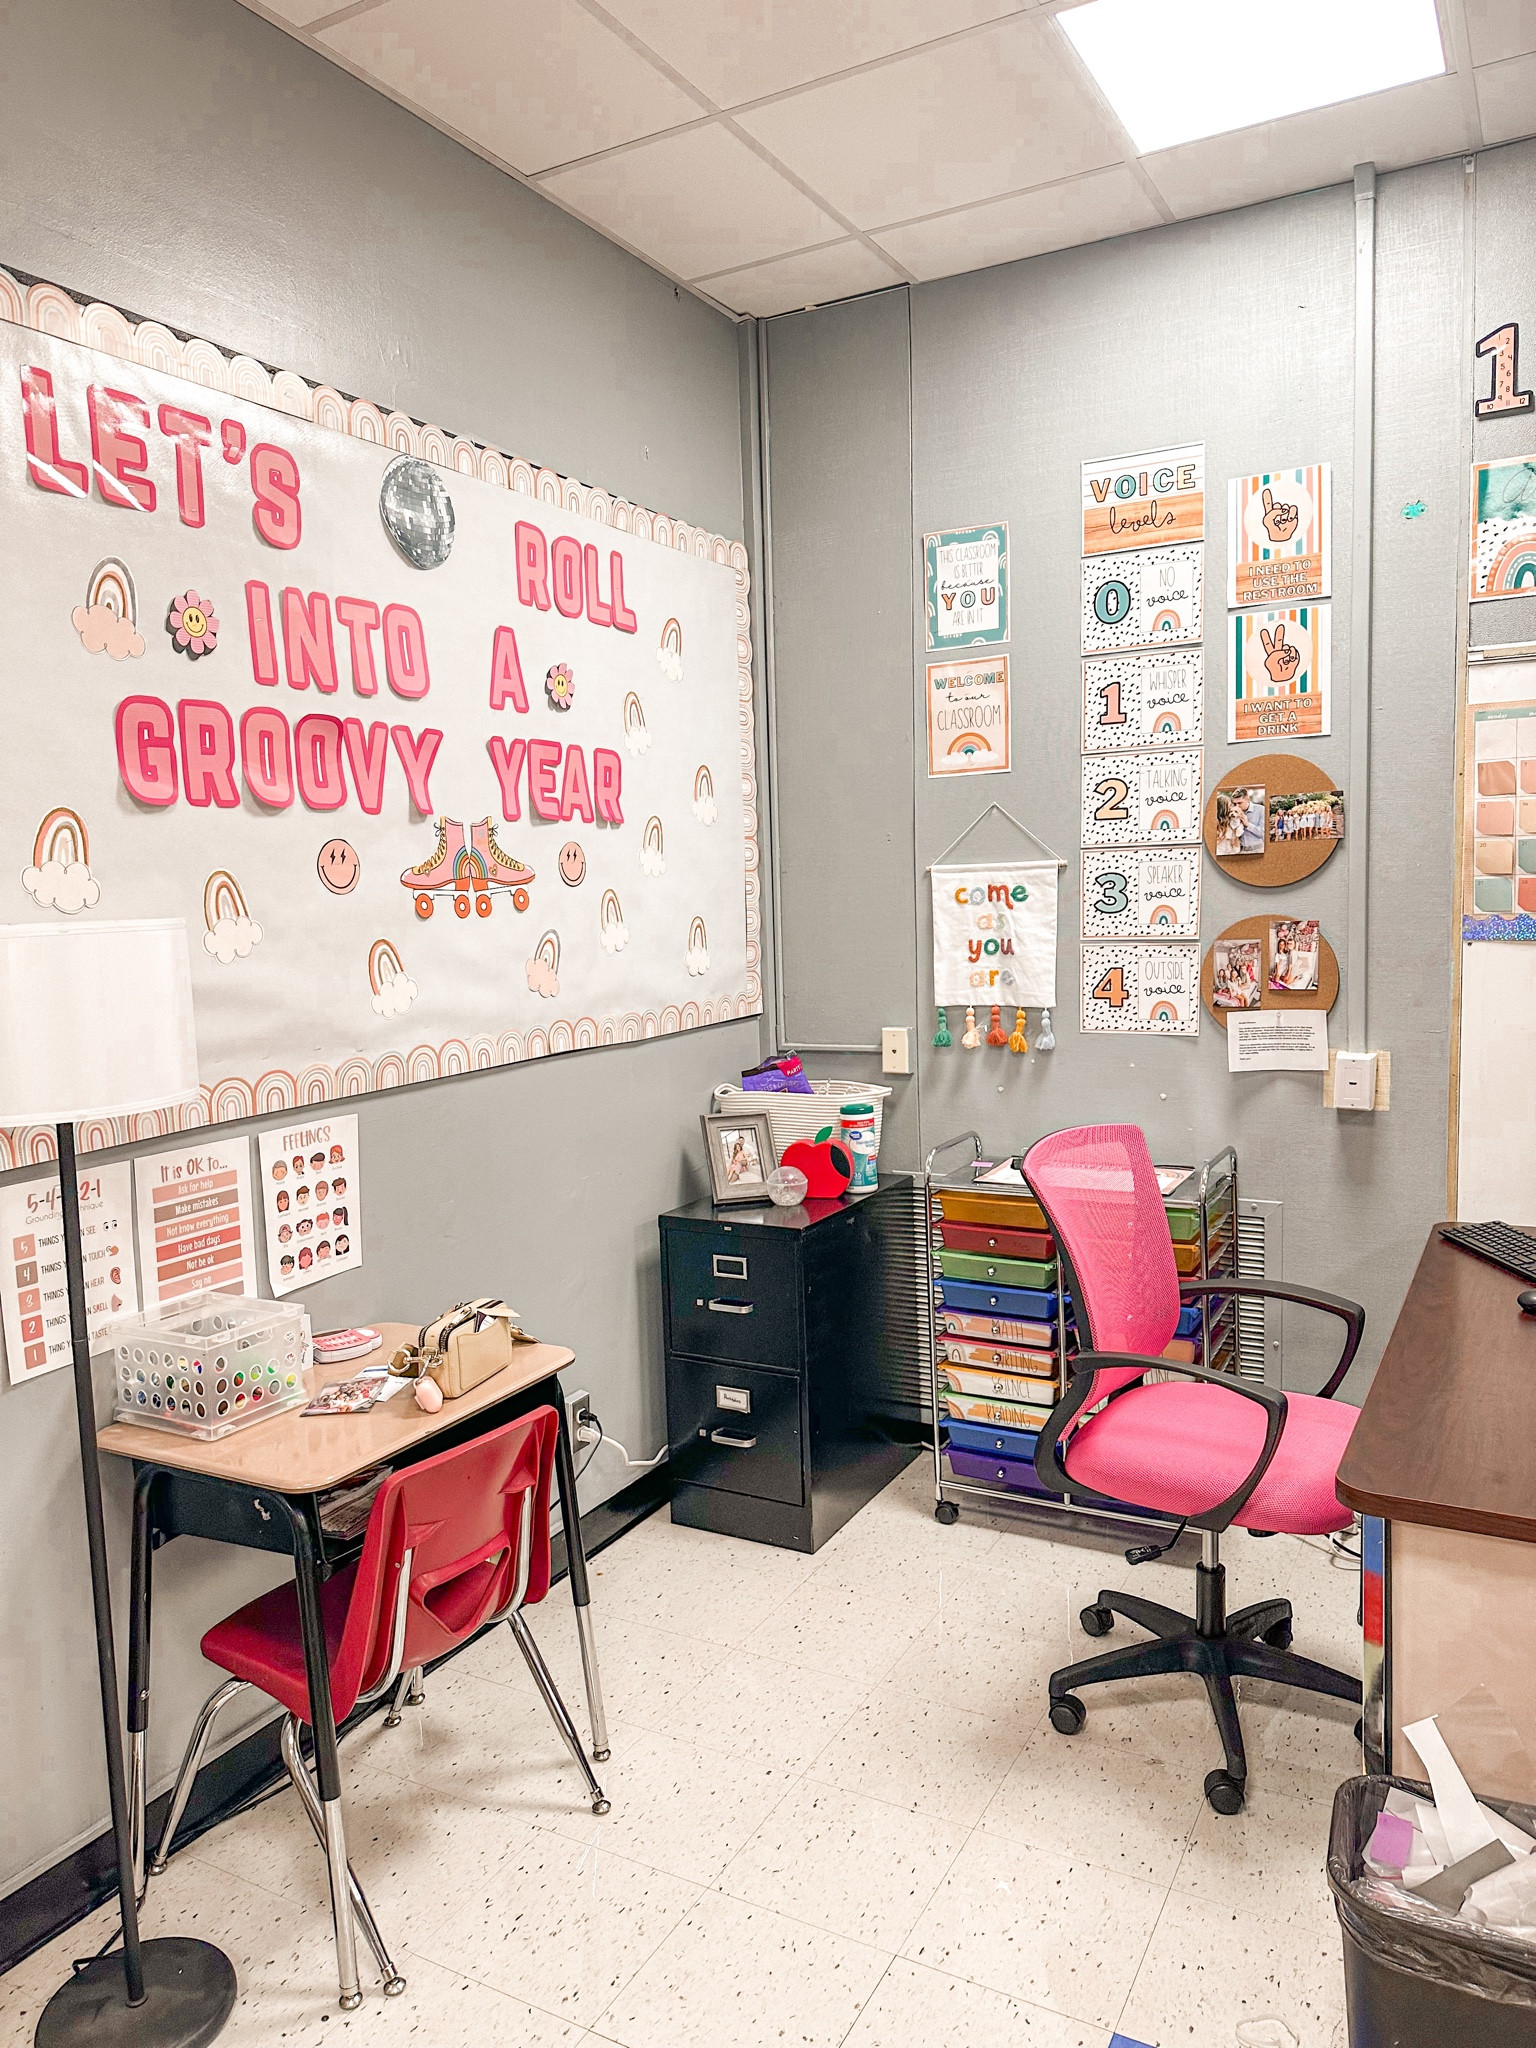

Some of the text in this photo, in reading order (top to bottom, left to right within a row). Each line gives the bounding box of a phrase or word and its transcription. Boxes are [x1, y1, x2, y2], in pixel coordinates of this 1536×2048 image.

[1475, 322, 1533, 417] 1
[1090, 464, 1196, 503] VOICE
[1110, 500, 1176, 534] levels
[940, 543, 996, 564] THIS CLASSROOM
[515, 520, 637, 633] ROLL
[954, 562, 983, 579] IS BETTER
[1160, 566, 1175, 587] NO
[1249, 559, 1312, 577] I NEED TO
[941, 579, 994, 591] because
[1253, 572, 1307, 589] USE THE
[941, 586, 996, 610] YOU
[1094, 580, 1131, 624] 0
[1146, 589, 1189, 607] voice
[1243, 583, 1318, 602] RESTROOM
[953, 608, 983, 626] ARE IN IT
[245, 580, 529, 713] INTO A
[934, 671, 1004, 690] WELCOME
[1150, 669, 1187, 691] WHISPER
[946, 692, 962, 702] to
[1100, 682, 1127, 725] 1
[1147, 692, 1189, 709] voice
[1244, 698, 1313, 714] I WANT TO
[937, 705, 1001, 730] CLASSROOM
[1258, 711, 1297, 724] GET A
[1257, 723, 1298, 736] DRINK
[116, 695, 624, 824] GROOVY YEAR
[1146, 768, 1188, 788] TALKING
[1094, 778, 1128, 820] 2
[1145, 792, 1188, 806] voice
[1146, 865, 1183, 884] SPEAKER
[955, 884, 1029, 910] come
[1093, 872, 1129, 914] 3
[1144, 888, 1185, 901] voice
[976, 913, 1006, 930] as
[968, 938, 1014, 963] you
[970, 969, 1015, 987] are
[1145, 961, 1184, 980] OUTSIDE
[1092, 967, 1129, 1008] 4
[1144, 984, 1185, 996] voice
[283, 1125, 331, 1152] FEELINGS
[161, 1166, 169, 1183] It
[173, 1166, 181, 1179] is
[187, 1157, 204, 1174] OK
[178, 1180, 214, 1194] Ask for help
[176, 1198, 218, 1215] Make mistakes
[167, 1214, 229, 1236] Not know everything
[20, 1241, 28, 1253] 5
[39, 1235, 59, 1248] THINGS
[86, 1226, 96, 1235] SEE
[178, 1235, 220, 1253] Have bad days
[24, 1269, 30, 1282] 4
[41, 1262, 62, 1274] THINGS
[89, 1250, 105, 1261] TOUCH
[186, 1255, 214, 1270] Not be ok
[26, 1294, 33, 1307] 3
[44, 1289, 64, 1302] THINGS
[91, 1277, 104, 1287] HEAR
[192, 1275, 212, 1289] Say no
[29, 1321, 36, 1334] 2
[46, 1315, 67, 1328] THINGS
[93, 1302, 108, 1313] SMELL
[992, 1319, 1023, 1340] MATH
[33, 1349, 37, 1362] 1
[49, 1341, 65, 1354] THING
[92, 1327, 108, 1339] TASTE
[986, 1403, 1030, 1428] READING
